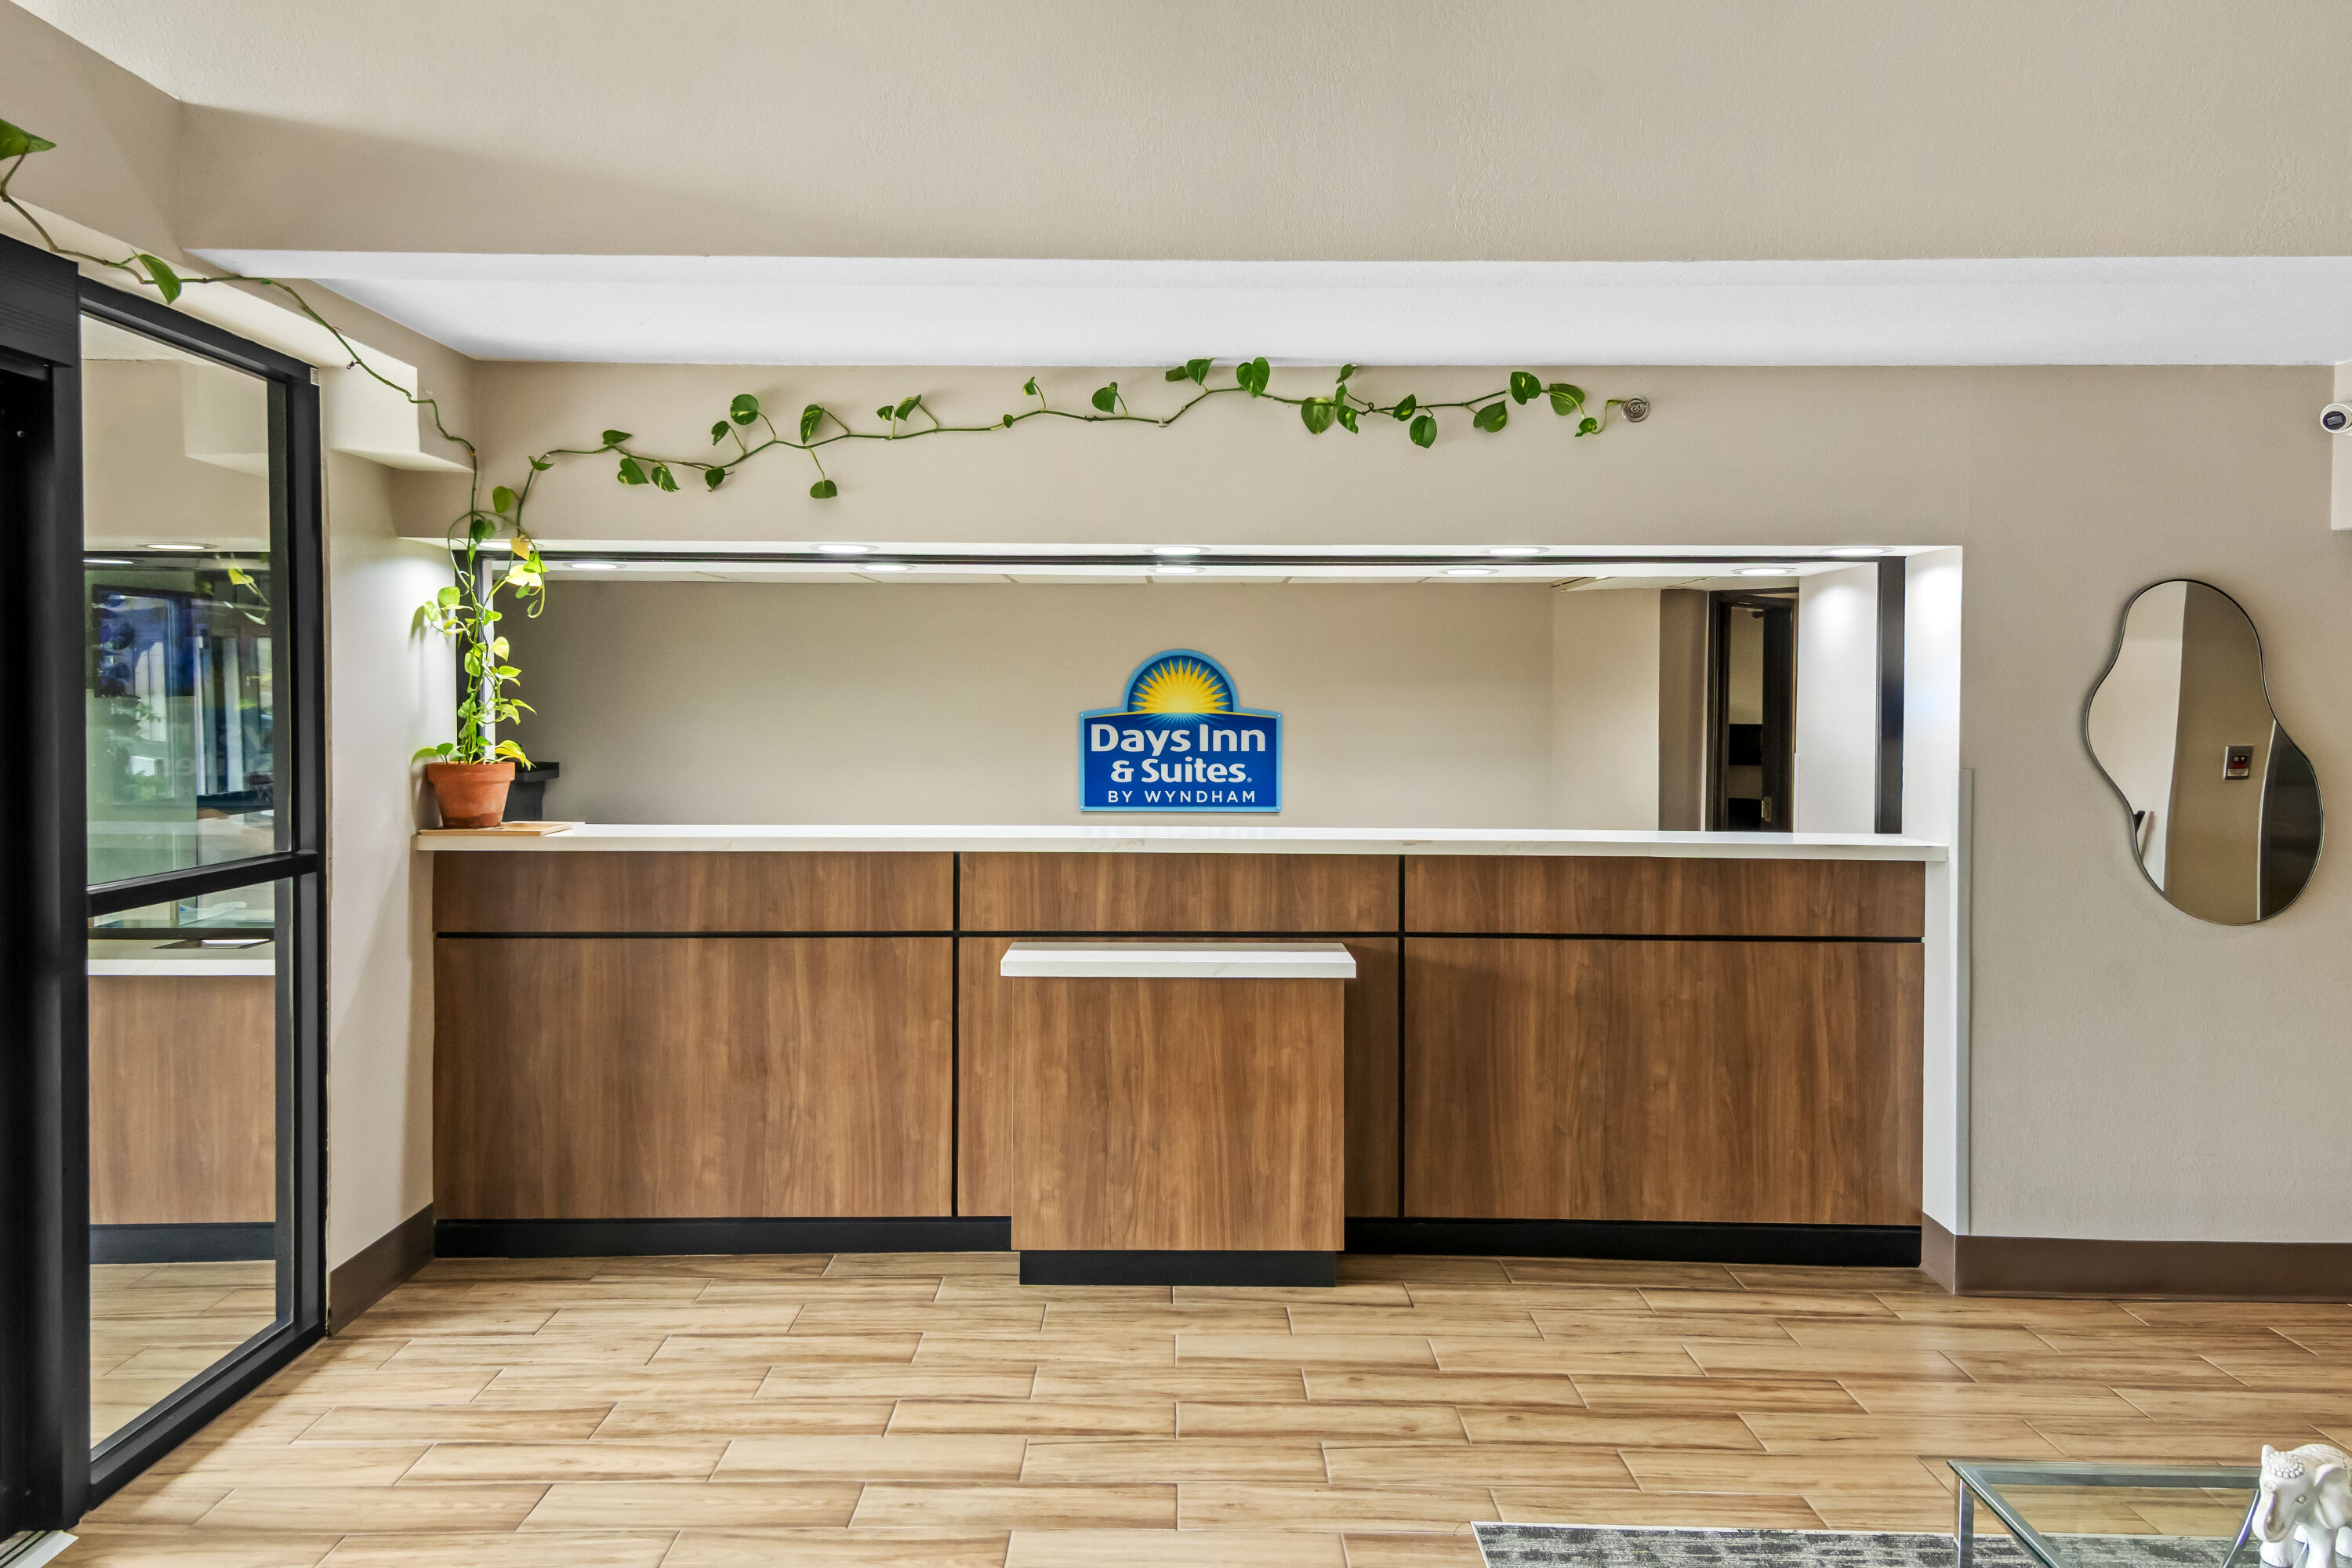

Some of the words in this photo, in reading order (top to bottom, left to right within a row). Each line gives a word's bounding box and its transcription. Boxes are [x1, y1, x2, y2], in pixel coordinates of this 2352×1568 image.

[1091, 724, 1191, 757] Days
[1199, 724, 1265, 752] Inn
[1110, 760, 1134, 783] &
[1108, 790, 1133, 803] BY
[1144, 790, 1255, 803] WYNDHAM
